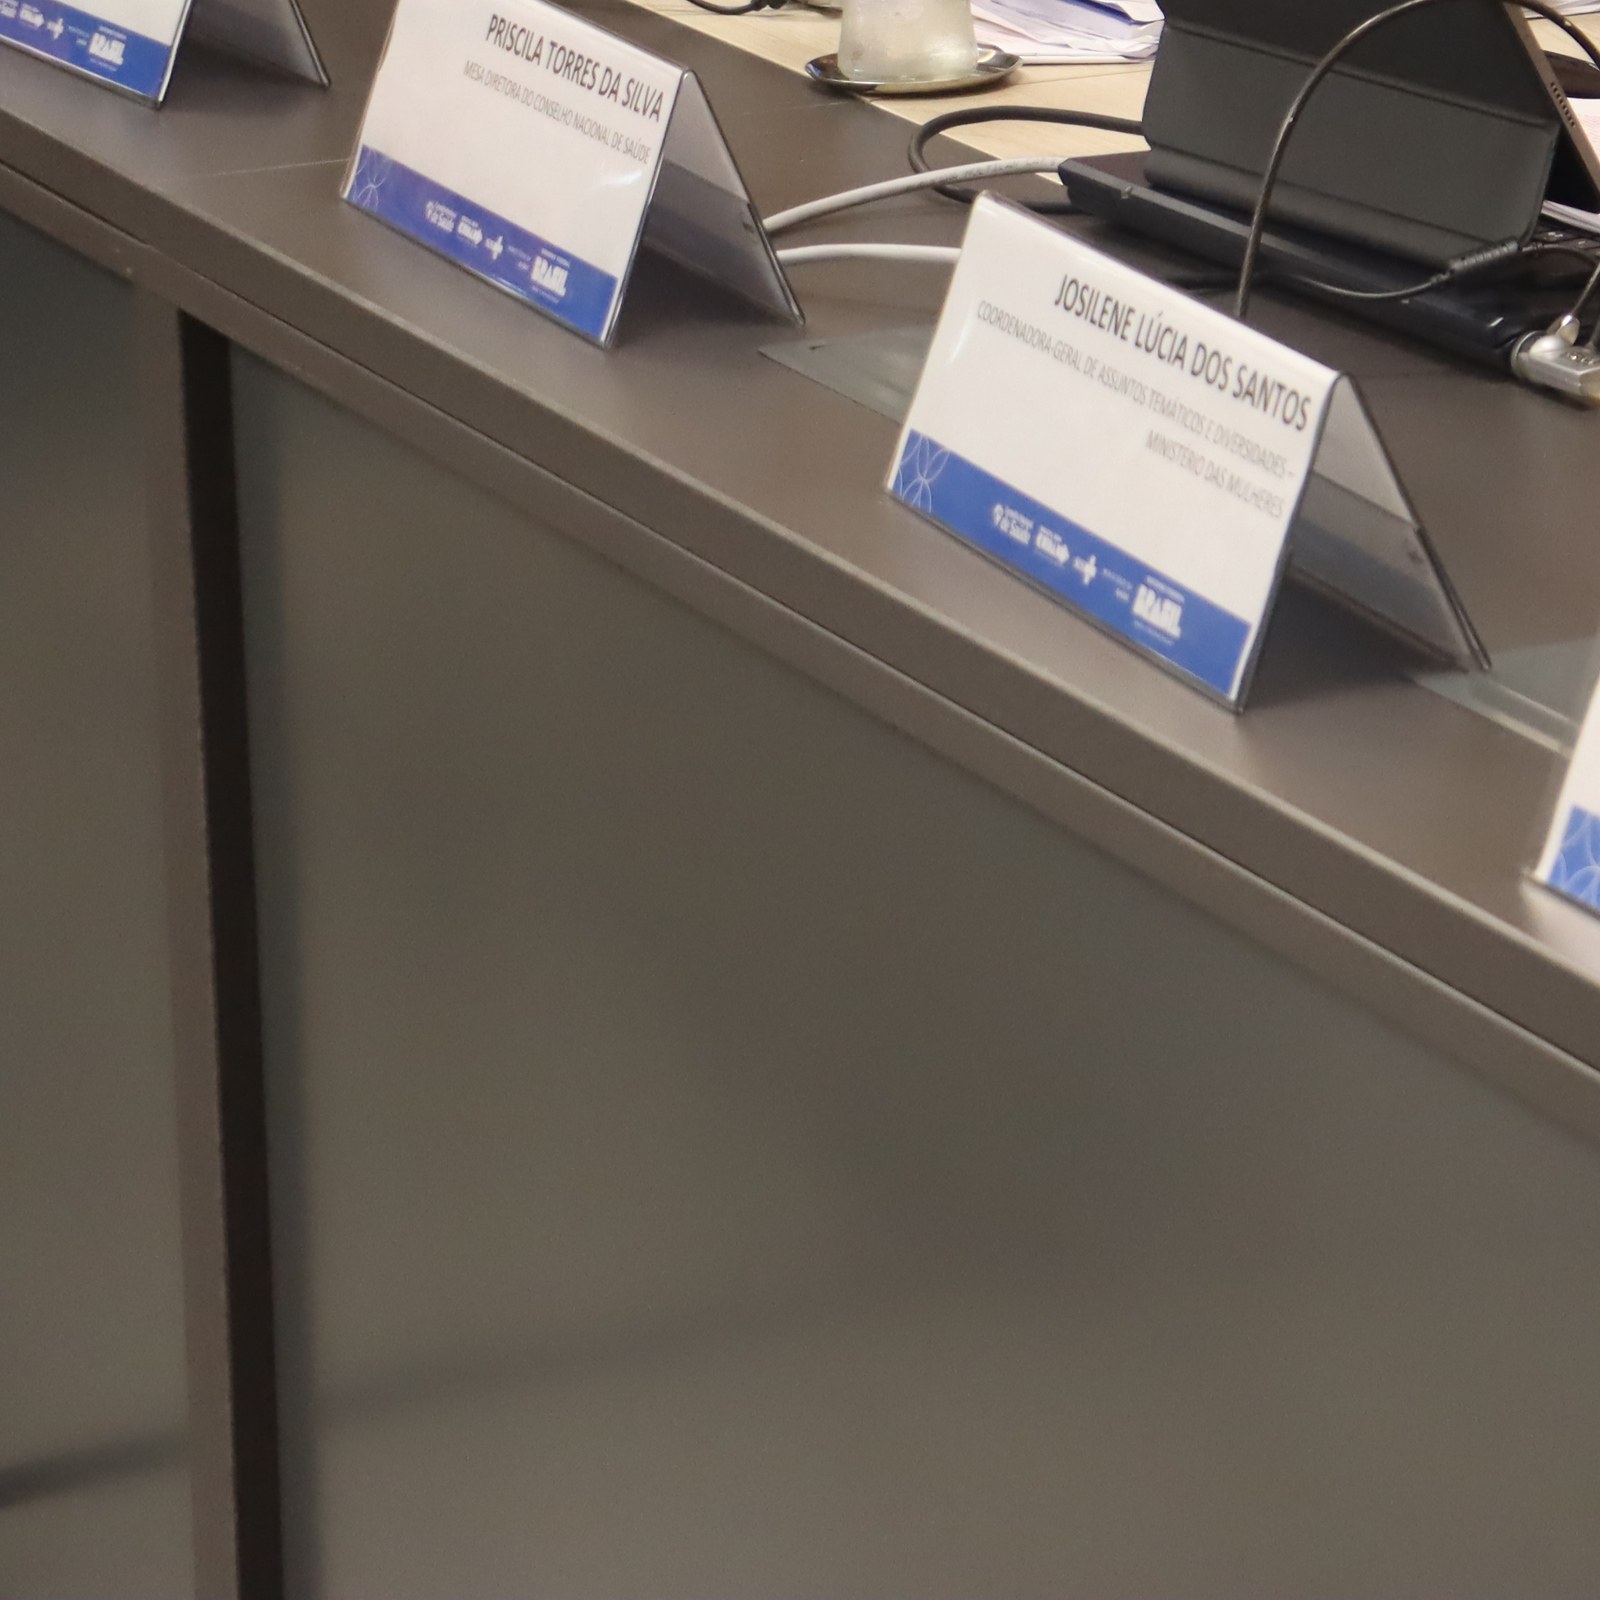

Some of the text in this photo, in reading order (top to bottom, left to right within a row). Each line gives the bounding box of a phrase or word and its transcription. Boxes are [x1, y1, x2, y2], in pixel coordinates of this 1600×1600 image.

[464, 59, 651, 165] MESA DIRETORA DO CONSELHO NACIONAL DE SAÚDE
[485, 13, 664, 123] PRISCILA TORRES DA SILVA
[976, 299, 1083, 373] COORDENADORA-GERAL
[1082, 355, 1100, 380] DE
[1098, 363, 1150, 406] ASSUNTOS
[1148, 387, 1208, 435] TEMÁTICOS
[1204, 419, 1215, 440] E
[1212, 423, 1288, 479] DIVERSIDADES
[1054, 273, 1312, 432] JOSILENE LÚCIA DOS SANTOS
[1146, 429, 1285, 519] MINISTÉRIO DAS MULHERES
